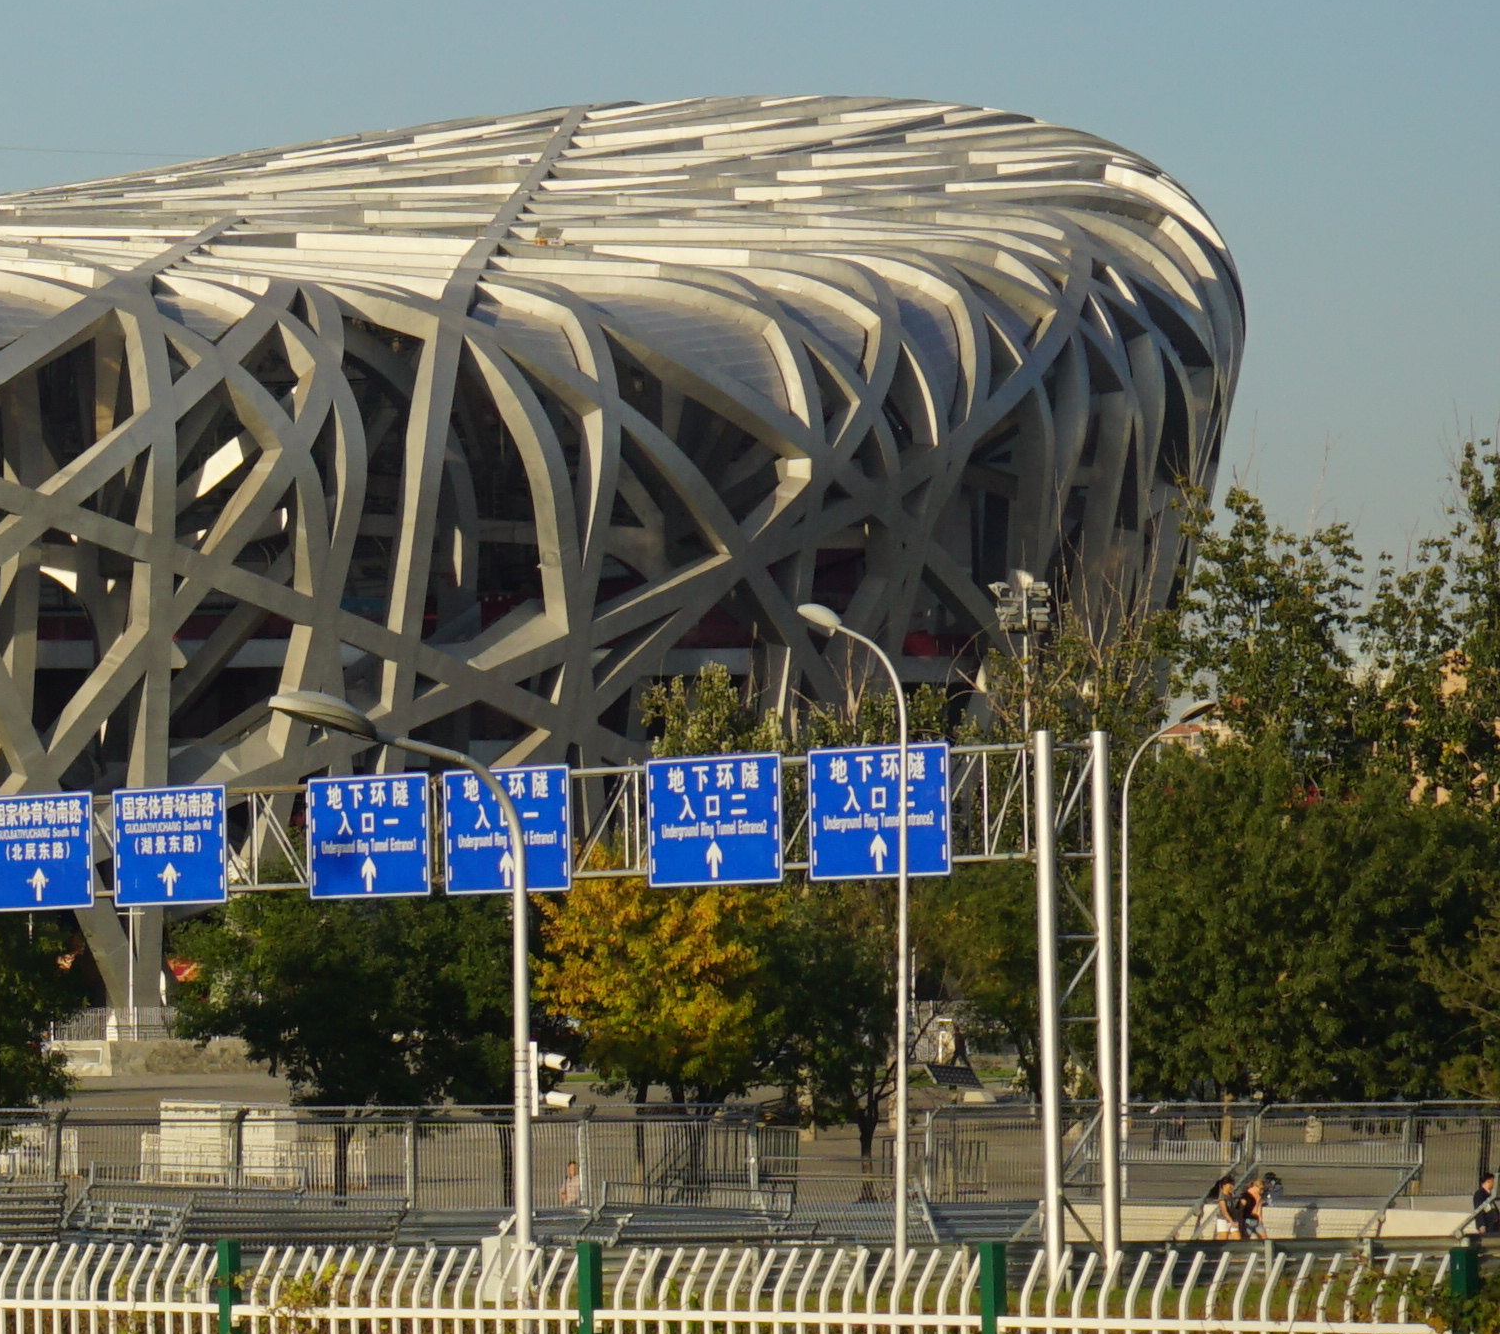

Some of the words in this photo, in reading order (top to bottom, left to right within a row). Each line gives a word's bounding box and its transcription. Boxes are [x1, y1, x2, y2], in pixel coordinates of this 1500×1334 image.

[667, 761, 759, 793] 地下环隧
[830, 752, 925, 784] 地下环隧
[122, 792, 215, 821] 国家体育场南路
[326, 780, 409, 810] 地下环隧
[679, 794, 748, 820] 入口二
[52, 827, 70, 838] South
[71, 826, 80, 837] Rd
[183, 819, 201, 832] South
[202, 819, 212, 831] Rd
[337, 811, 399, 835] 入口一
[661, 822, 699, 841] Underground
[700, 821, 714, 840] Ring
[715, 819, 736, 835] Tunnel
[738, 819, 767, 834] Entrance2
[822, 813, 862, 833] Underground
[863, 812, 878, 831] Ring
[906, 810, 935, 826] ntrance2
[321, 840, 355, 857] Underground
[356, 839, 369, 856] Ring
[370, 837, 389, 852] Tunnel
[458, 833, 493, 851] Underground
[494, 831, 507, 849] Ring
